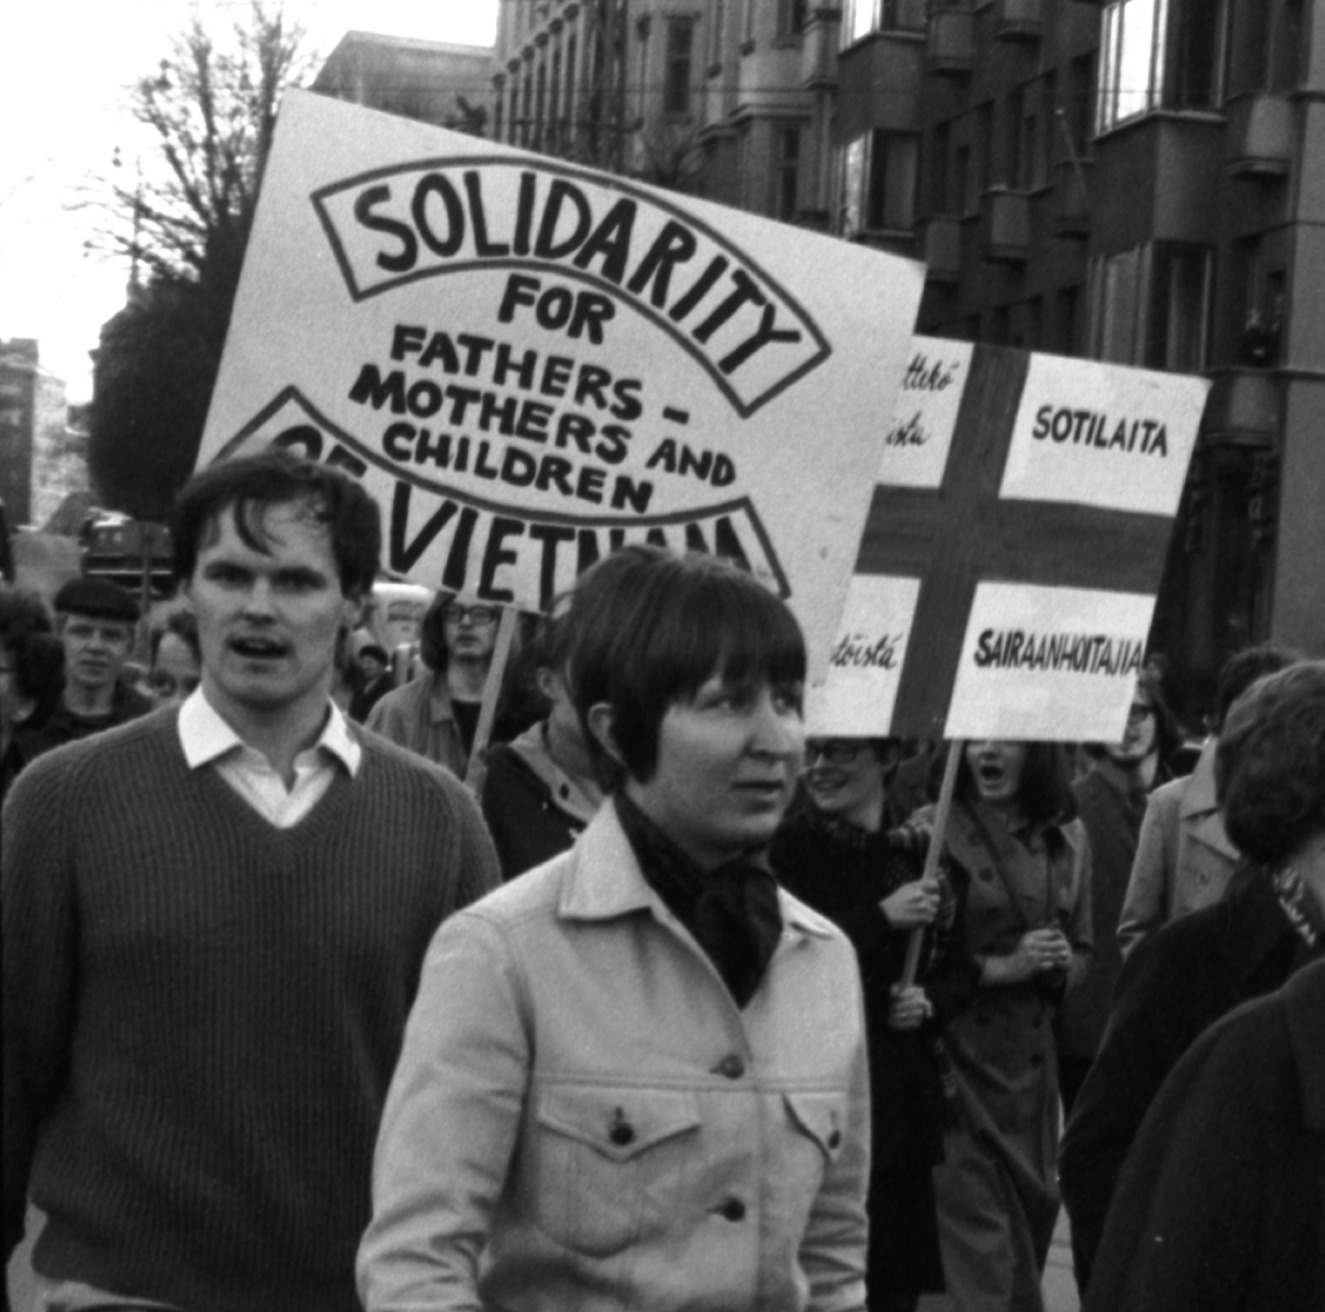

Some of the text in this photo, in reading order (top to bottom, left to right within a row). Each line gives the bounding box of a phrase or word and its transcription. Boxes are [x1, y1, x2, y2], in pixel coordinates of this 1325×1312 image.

[353, 170, 802, 376] SOLIDARITY
[496, 272, 617, 346] FOR
[389, 323, 644, 422] FATHERS
[347, 362, 737, 488] MOTHERS AND
[381, 420, 654, 515] CHILDREN
[1030, 404, 1169, 458] SOTILAITA
[388, 480, 754, 617] VIET
[973, 627, 1145, 677] SAIRAANHOITAJIA
